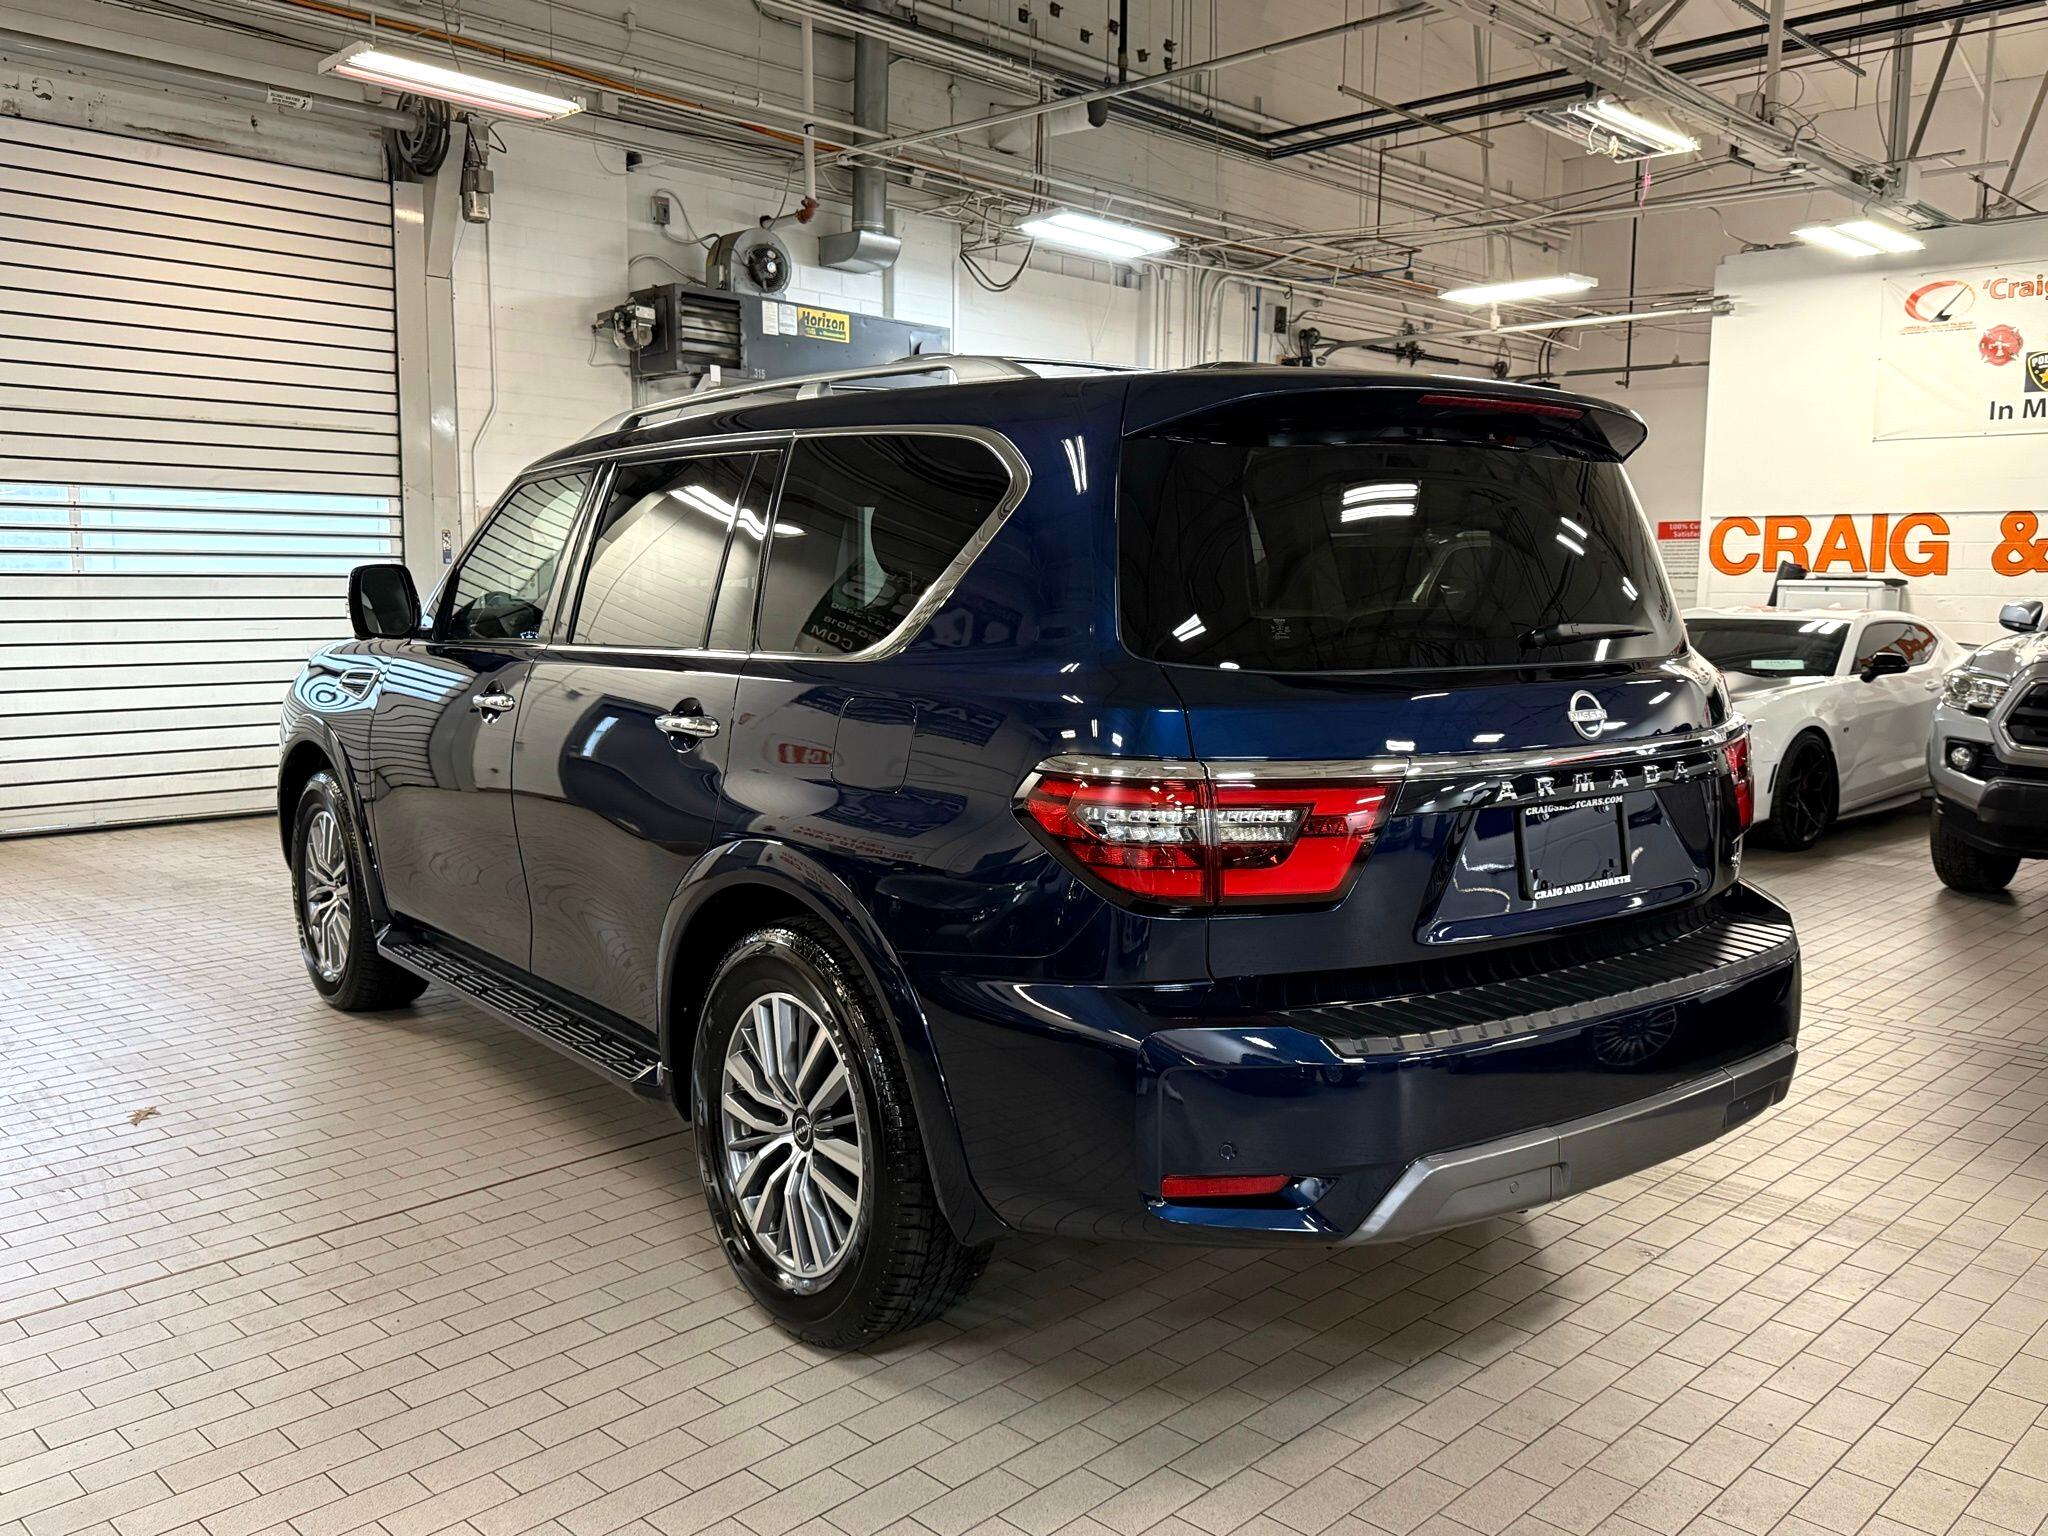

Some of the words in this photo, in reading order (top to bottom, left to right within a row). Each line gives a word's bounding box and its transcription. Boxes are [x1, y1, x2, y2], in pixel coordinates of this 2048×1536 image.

[802, 311, 846, 331] Horizon
[753, 368, 766, 379] 315
[1989, 400, 2014, 420] In
[1709, 513, 1950, 577] CRAIG
[1991, 511, 2048, 577] &
[1495, 761, 1690, 802] ARMADA
[1534, 887, 1563, 900] CRAIG
[1564, 883, 1585, 895] AND
[1585, 875, 1632, 890] LANDRETH
